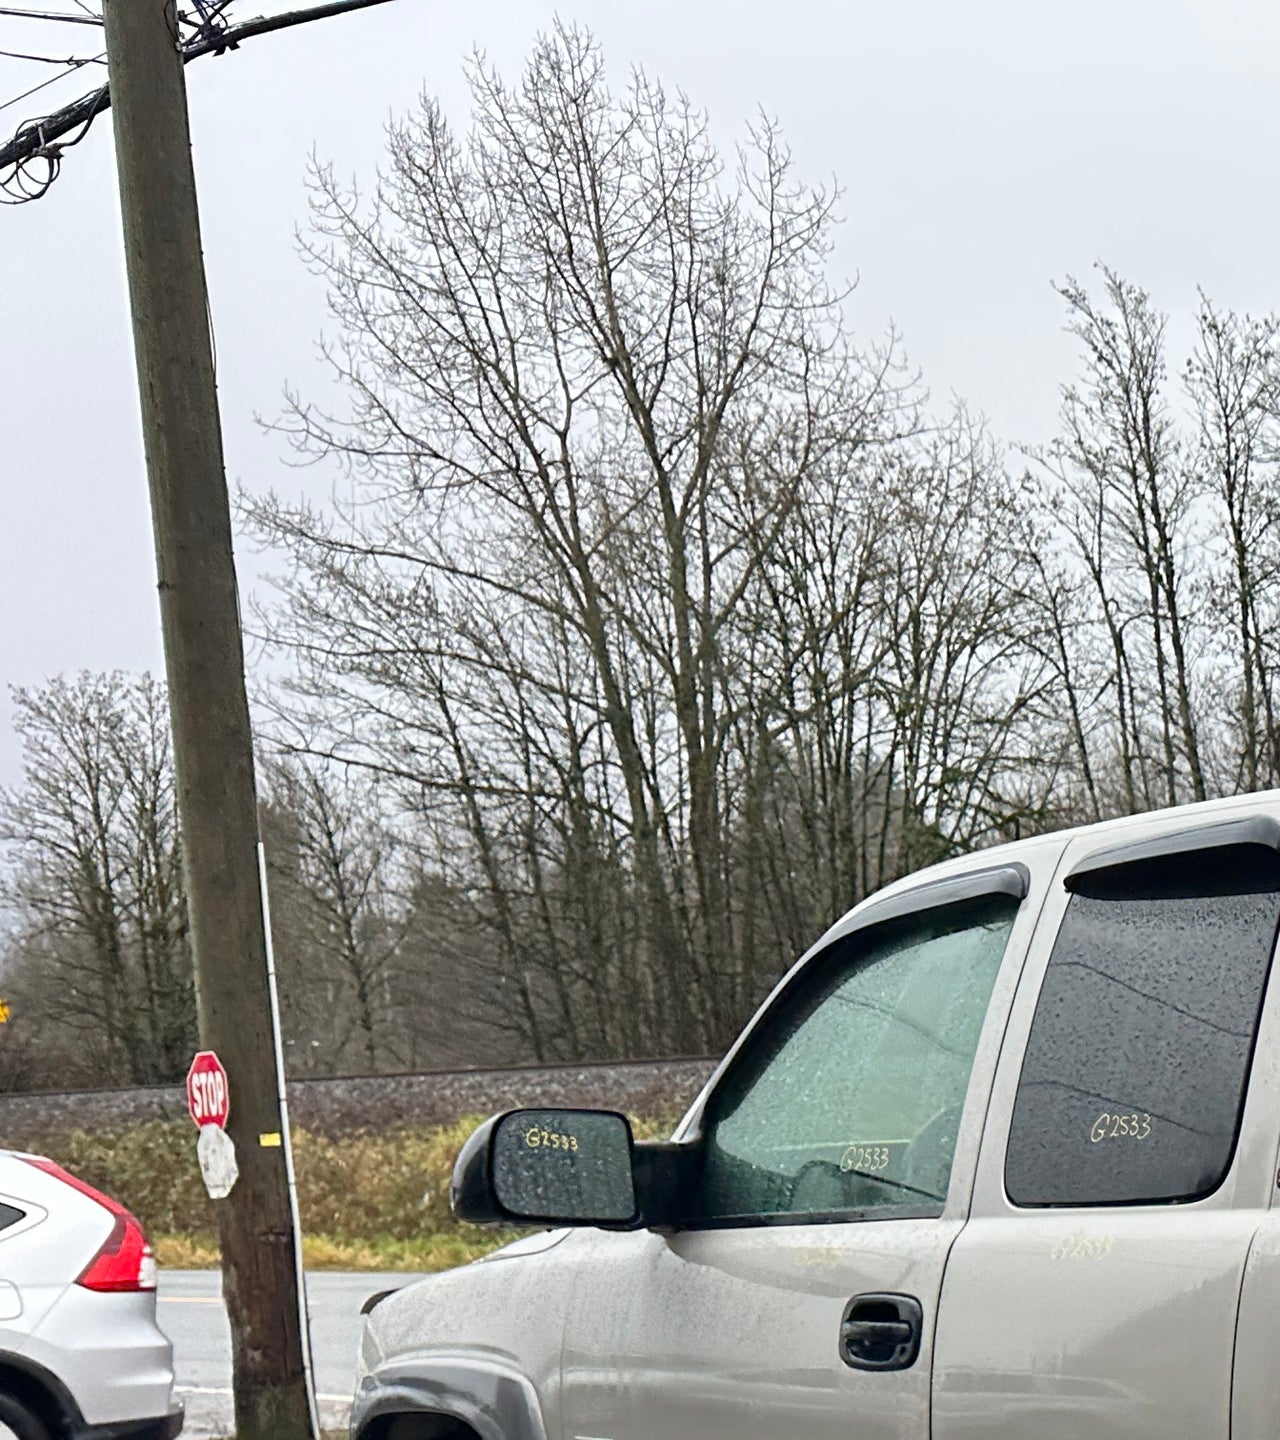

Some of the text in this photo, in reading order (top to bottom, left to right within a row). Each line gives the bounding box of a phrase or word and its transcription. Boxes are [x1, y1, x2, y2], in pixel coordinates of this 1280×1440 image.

[191, 1070, 226, 1118] STOP
[525, 1127, 579, 1151] G2533
[1090, 1113, 1152, 1142] G2533
[840, 1146, 889, 1172] G2533
